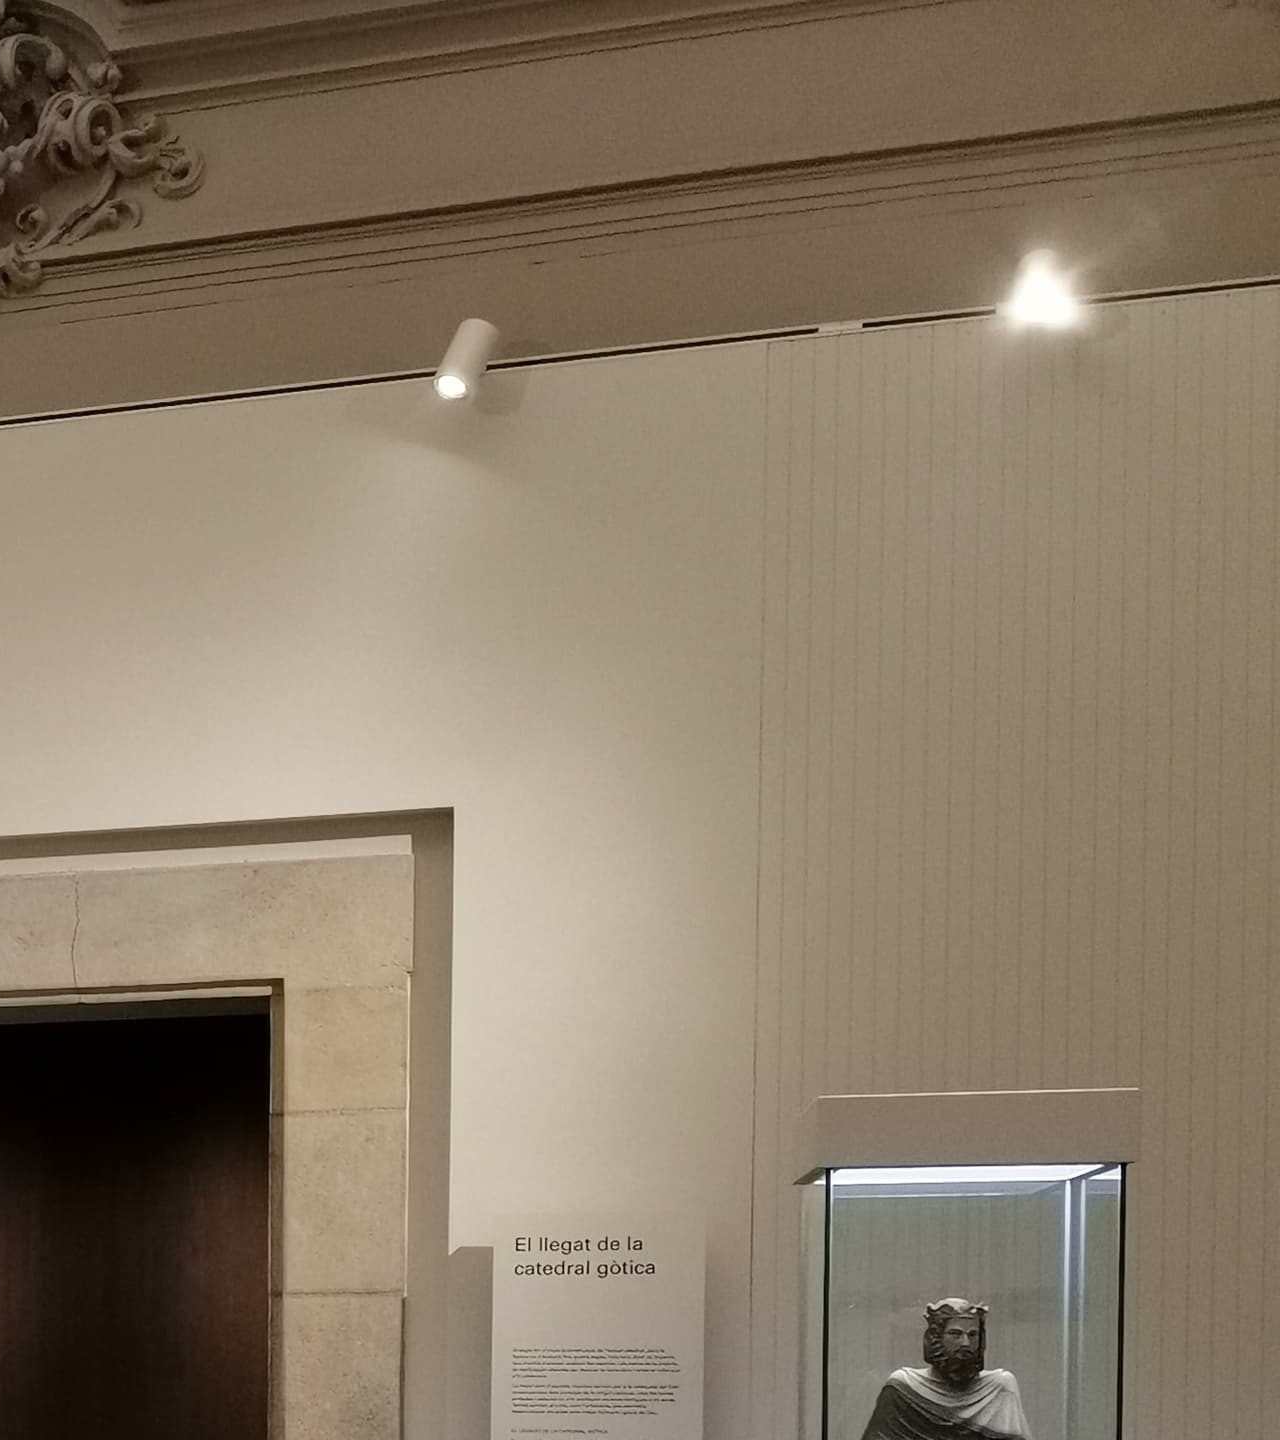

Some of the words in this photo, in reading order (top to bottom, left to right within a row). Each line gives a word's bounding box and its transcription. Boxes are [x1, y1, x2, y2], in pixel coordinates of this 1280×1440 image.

[515, 1237, 531, 1251] El
[539, 1236, 591, 1255] llegat
[597, 1236, 621, 1251] de
[627, 1236, 644, 1251] la
[514, 1260, 590, 1276] catedral
[597, 1259, 656, 1278] gòtica
